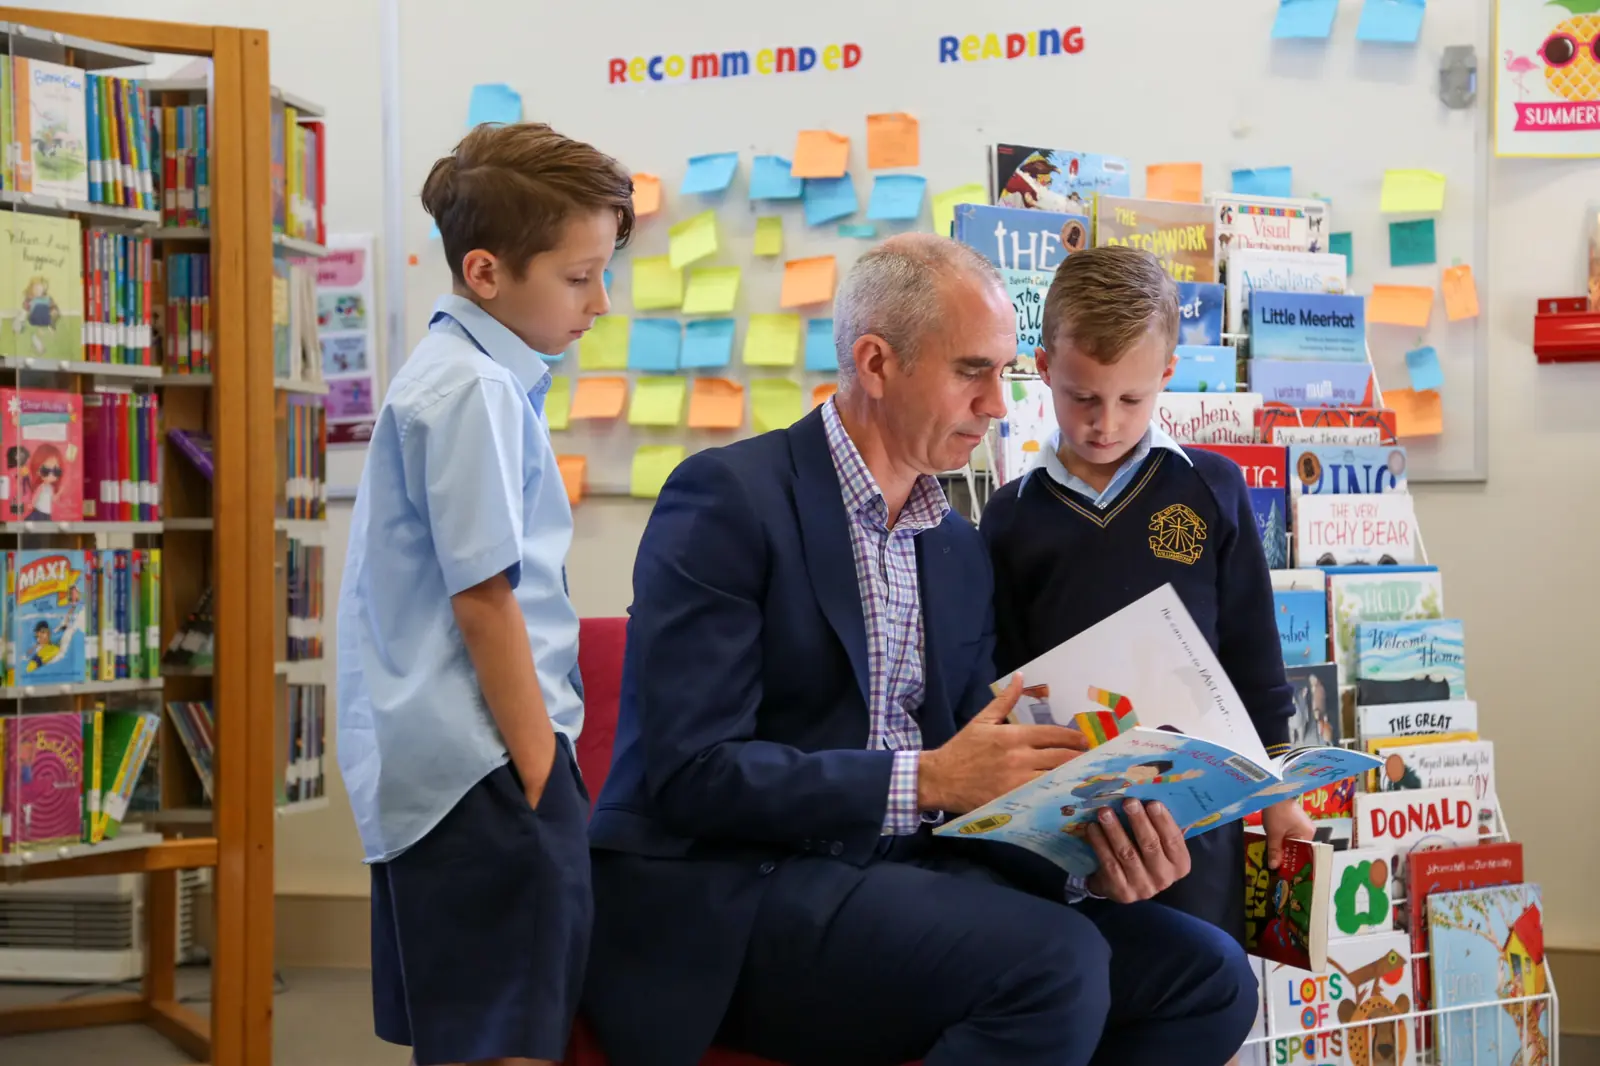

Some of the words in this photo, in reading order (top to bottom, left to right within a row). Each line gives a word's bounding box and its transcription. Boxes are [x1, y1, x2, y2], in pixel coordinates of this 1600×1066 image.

[1114, 206, 1137, 227] THE
[1252, 216, 1291, 239] Visual
[1160, 260, 1196, 281] IKE
[1016, 287, 1040, 306] The
[1012, 303, 1042, 331] ill
[1261, 306, 1296, 325] Little
[1299, 308, 1355, 328] Meerkat
[1159, 400, 1241, 442] Stephen's
[1276, 430, 1294, 442] Are
[1300, 434, 1315, 444] we
[1321, 430, 1349, 444] there
[1355, 431, 1379, 445] yet?
[1330, 503, 1348, 518] THE
[1354, 502, 1379, 518] VERY
[1308, 520, 1358, 545] ITCHY
[1362, 520, 1410, 546] BEAR
[20, 559, 67, 589] MAXI
[1364, 587, 1409, 613] HOLD
[1367, 627, 1427, 650] Welcome
[1416, 636, 1461, 667] Home
[1198, 668, 1218, 691] FAST
[1388, 714, 1412, 733] THE
[1415, 712, 1453, 731] GREAT
[1369, 797, 1473, 839] DONALD
[1288, 972, 1343, 1006] LOTS
[1300, 1003, 1330, 1031] OF
[1275, 1029, 1343, 1065] SPOTS
